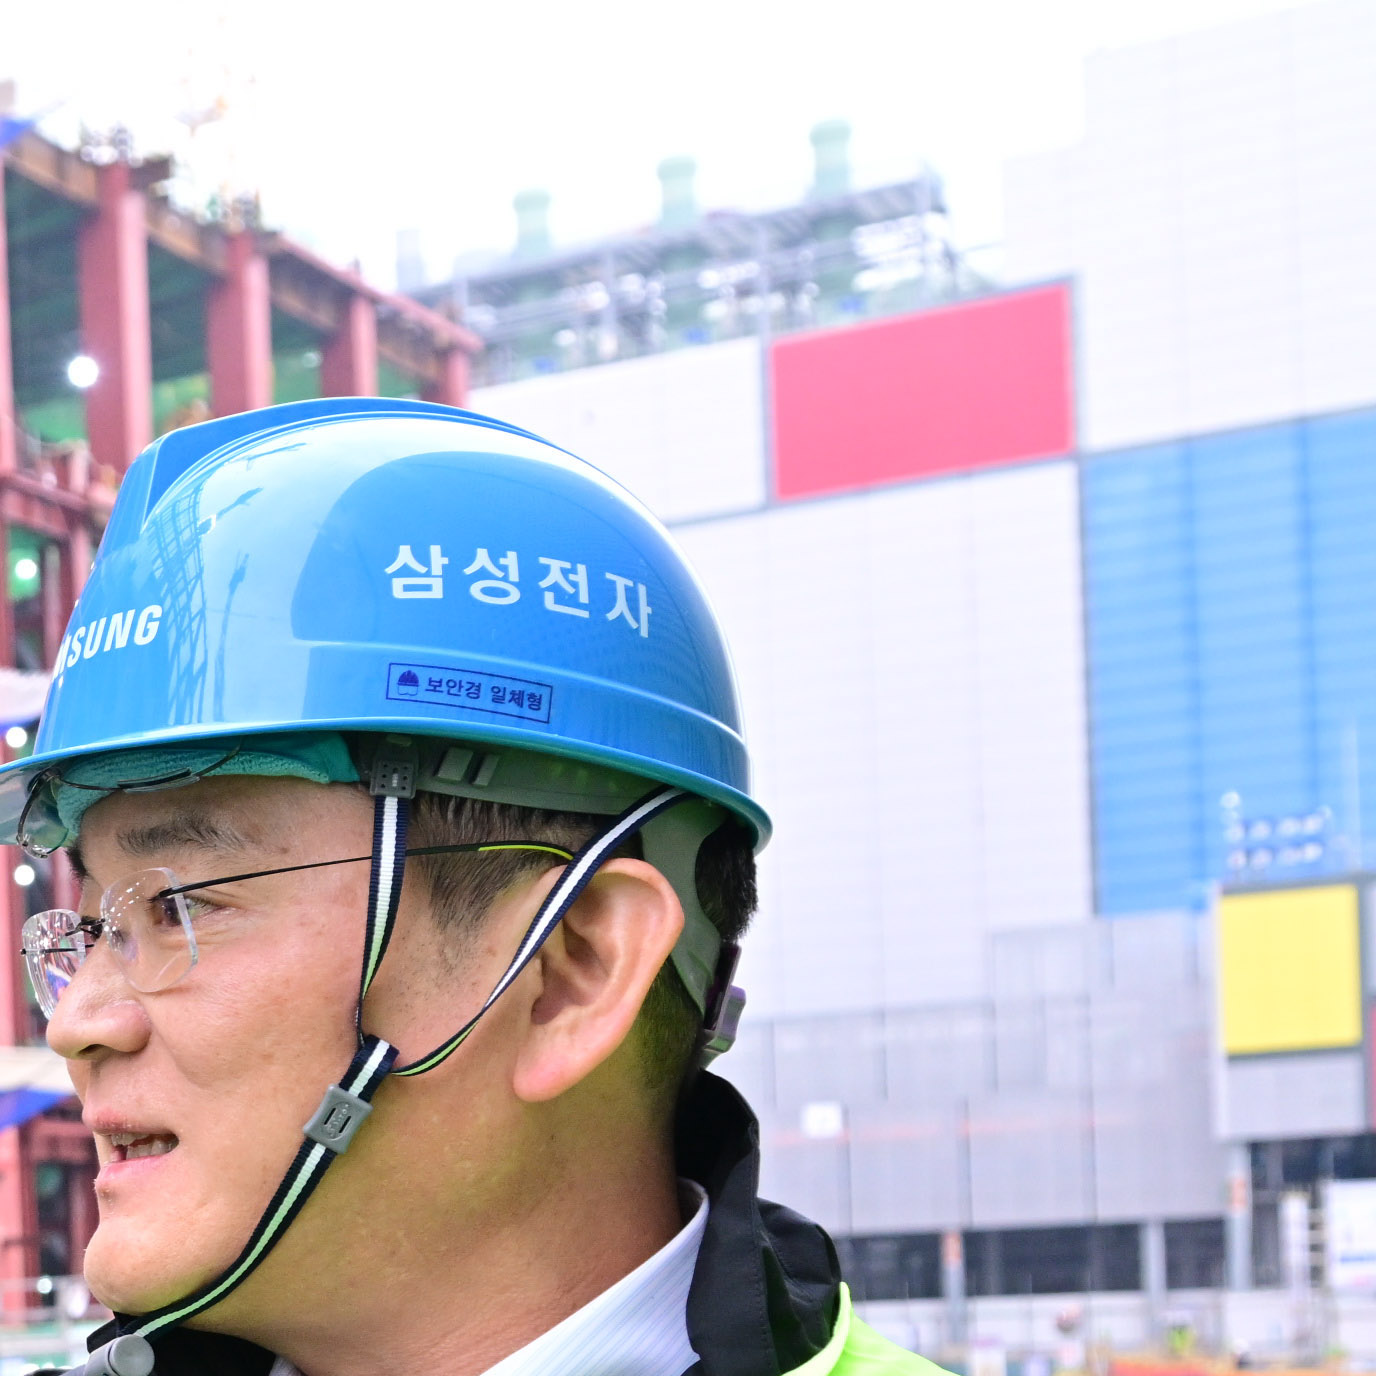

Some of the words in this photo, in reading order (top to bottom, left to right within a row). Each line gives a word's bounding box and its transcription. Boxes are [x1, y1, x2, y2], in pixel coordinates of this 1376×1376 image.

[384, 545, 652, 638] 삼성전자
[425, 677, 481, 700] 보안경
[490, 685, 543, 711] 일체형
